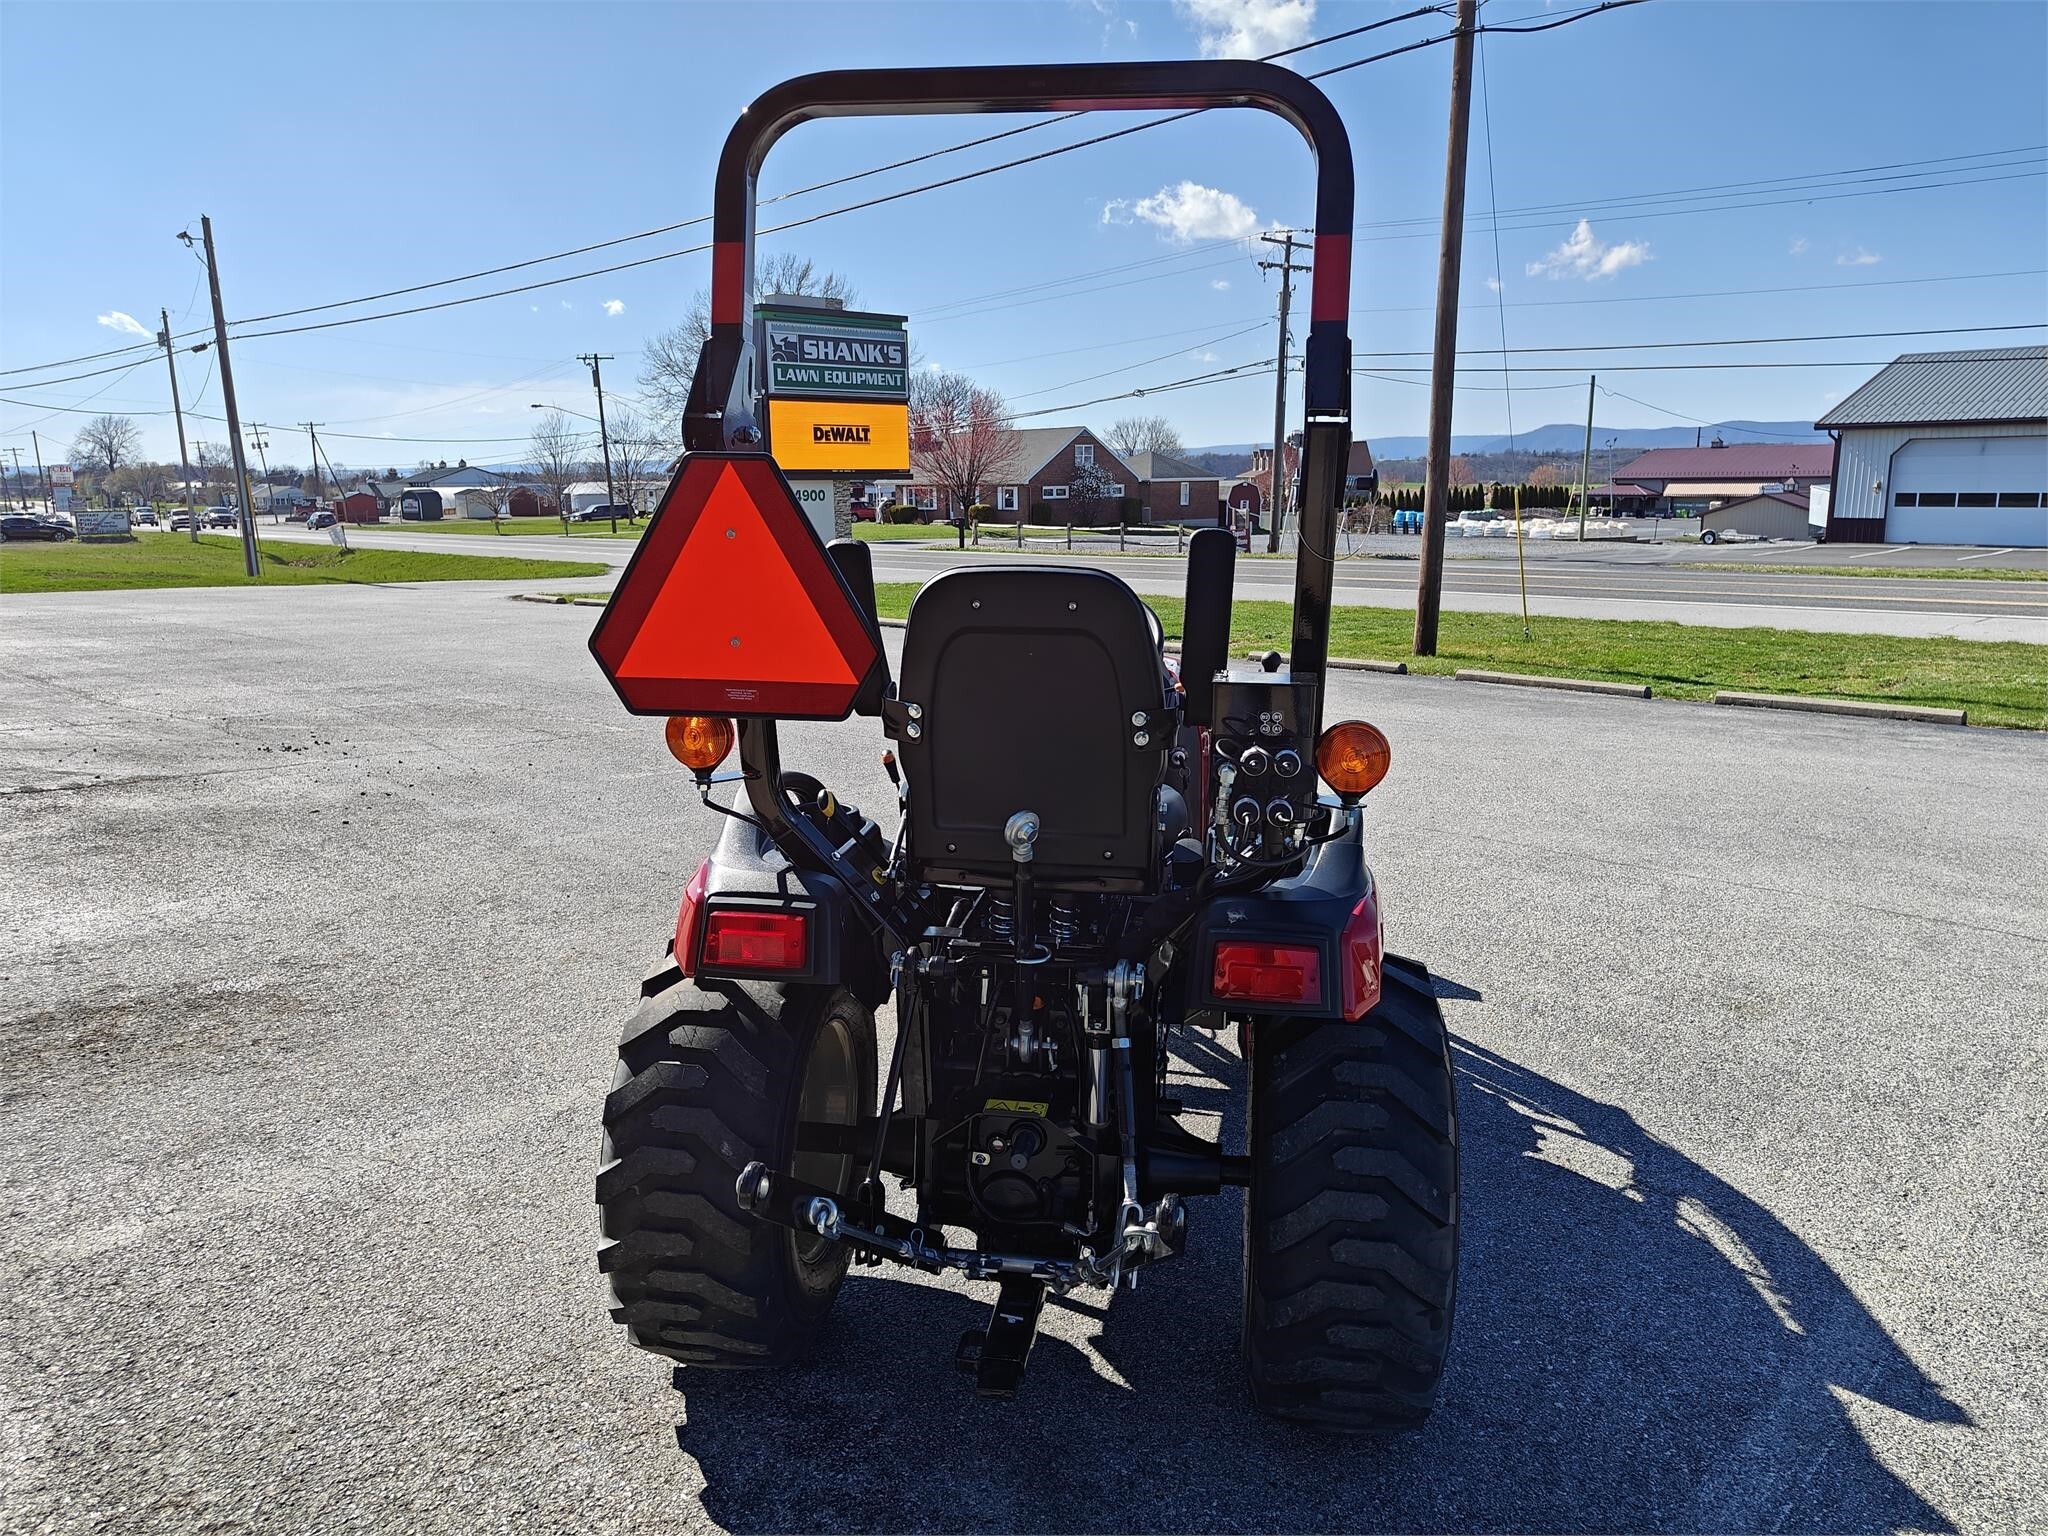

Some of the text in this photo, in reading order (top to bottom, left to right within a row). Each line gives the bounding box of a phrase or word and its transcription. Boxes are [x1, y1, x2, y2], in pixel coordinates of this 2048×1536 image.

[803, 340, 902, 364] SHANK'S
[777, 368, 903, 386] LAWN EQUIPMENT
